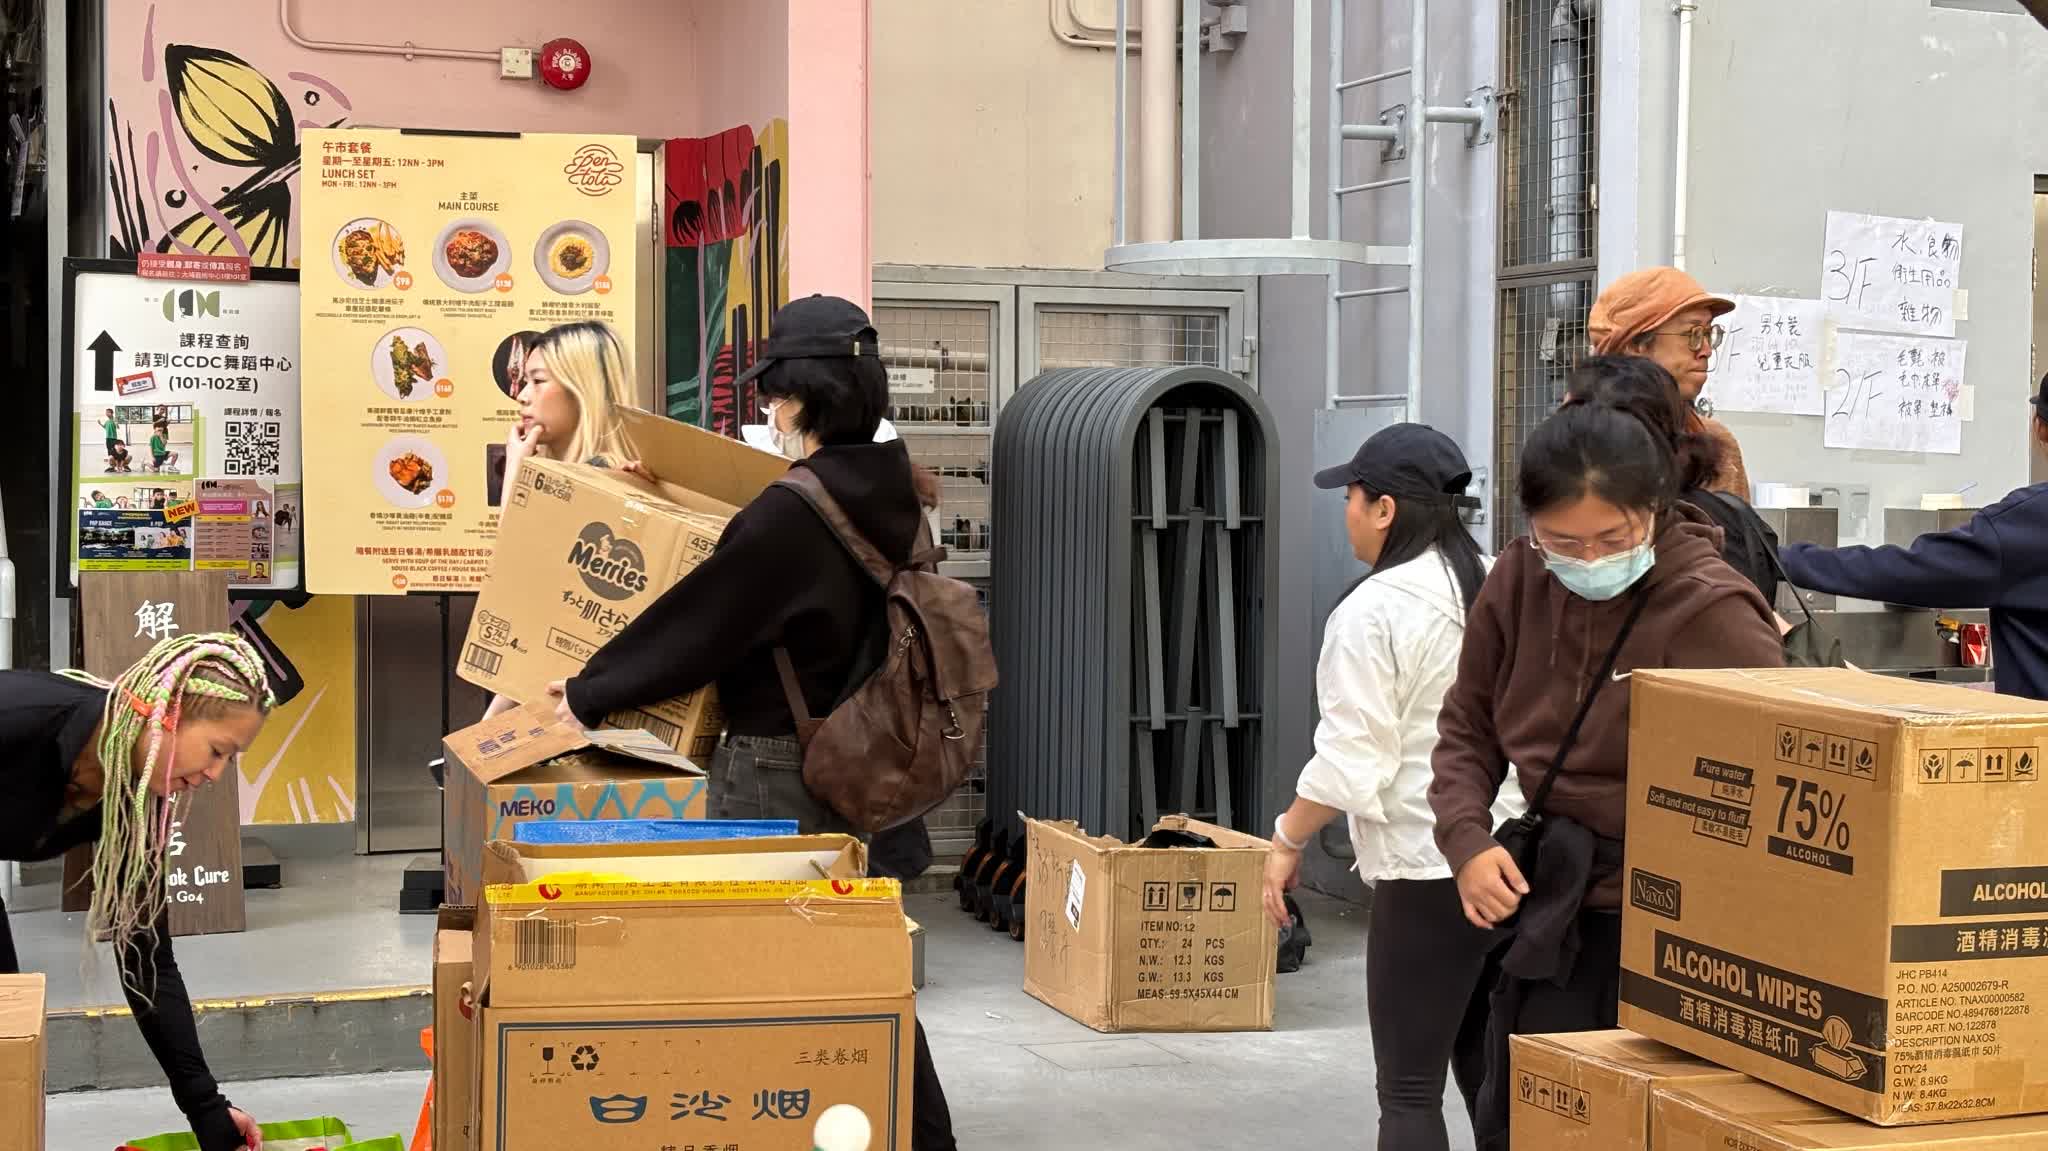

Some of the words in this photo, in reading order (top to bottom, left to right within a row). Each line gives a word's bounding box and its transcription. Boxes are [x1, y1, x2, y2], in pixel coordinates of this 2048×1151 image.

[322, 141, 372, 154] 午市套餐
[398, 159, 419, 167] 12NN
[426, 159, 444, 168] 3PM
[322, 170, 355, 178] LUNCH
[357, 170, 376, 179] SET
[459, 192, 478, 200] 主菜
[438, 202, 462, 211] MAIN
[464, 202, 499, 212] COURSE
[1828, 250, 1878, 310] 3/F
[1898, 296, 1942, 327] 雜物
[1760, 314, 1802, 336] 男女裝
[180, 332, 250, 350] 課程查詢
[134, 352, 292, 372] 請到CCDC舞蹈中心
[1758, 352, 1814, 372] 兒童衣服
[168, 376, 258, 394] (101-102室)
[1831, 368, 1884, 418] 2/F
[168, 502, 195, 518] NEW
[568, 538, 648, 592] Merries
[134, 600, 180, 640] 解
[1701, 760, 1720, 776] Pure
[1722, 766, 1746, 781] water
[1650, 790, 1665, 802] Soft
[1666, 794, 1680, 808] and
[1682, 799, 1696, 812] not
[1697, 804, 1716, 820] easy
[1718, 808, 1726, 820] to
[1776, 774, 1849, 850] 75%
[1786, 844, 1832, 867] ALCOHOL
[194, 866, 229, 886] Cure
[1140, 921, 1164, 932] ITEM
[1182, 938, 1192, 949] 24
[1205, 939, 1225, 949] PCS
[1956, 926, 2048, 952] 酒精消毒
[1174, 955, 1192, 965] 12.3
[1204, 955, 1224, 965] KGS
[1174, 972, 1192, 982] 13.3
[1204, 972, 1224, 982] KGS
[1663, 943, 1752, 998] ALCOHOL
[1756, 973, 1823, 1020] WIPES
[1896, 970, 1917, 980] JHC
[1919, 969, 1947, 979] PB414
[1224, 989, 1239, 998] CM
[1898, 984, 1918, 994] P.O.
[1921, 983, 1939, 993] NO.
[1941, 980, 2009, 993] A250002679-R
[1896, 998, 1937, 1008] ARTICLE
[1940, 997, 1957, 1006] NO.
[1896, 1010, 1944, 1022] BARCODE
[1680, 994, 1799, 1058] 酒精消毒濕紙巾
[1896, 1025, 1924, 1034] SUPP.
[1926, 1024, 1946, 1033] ART.
[1894, 1035, 1960, 1048] DESCRIPTION
[1962, 1033, 1995, 1043] NAXOS
[794, 1047, 868, 1066] 三类卷烟
[590, 1088, 810, 1124] 白沙烟
